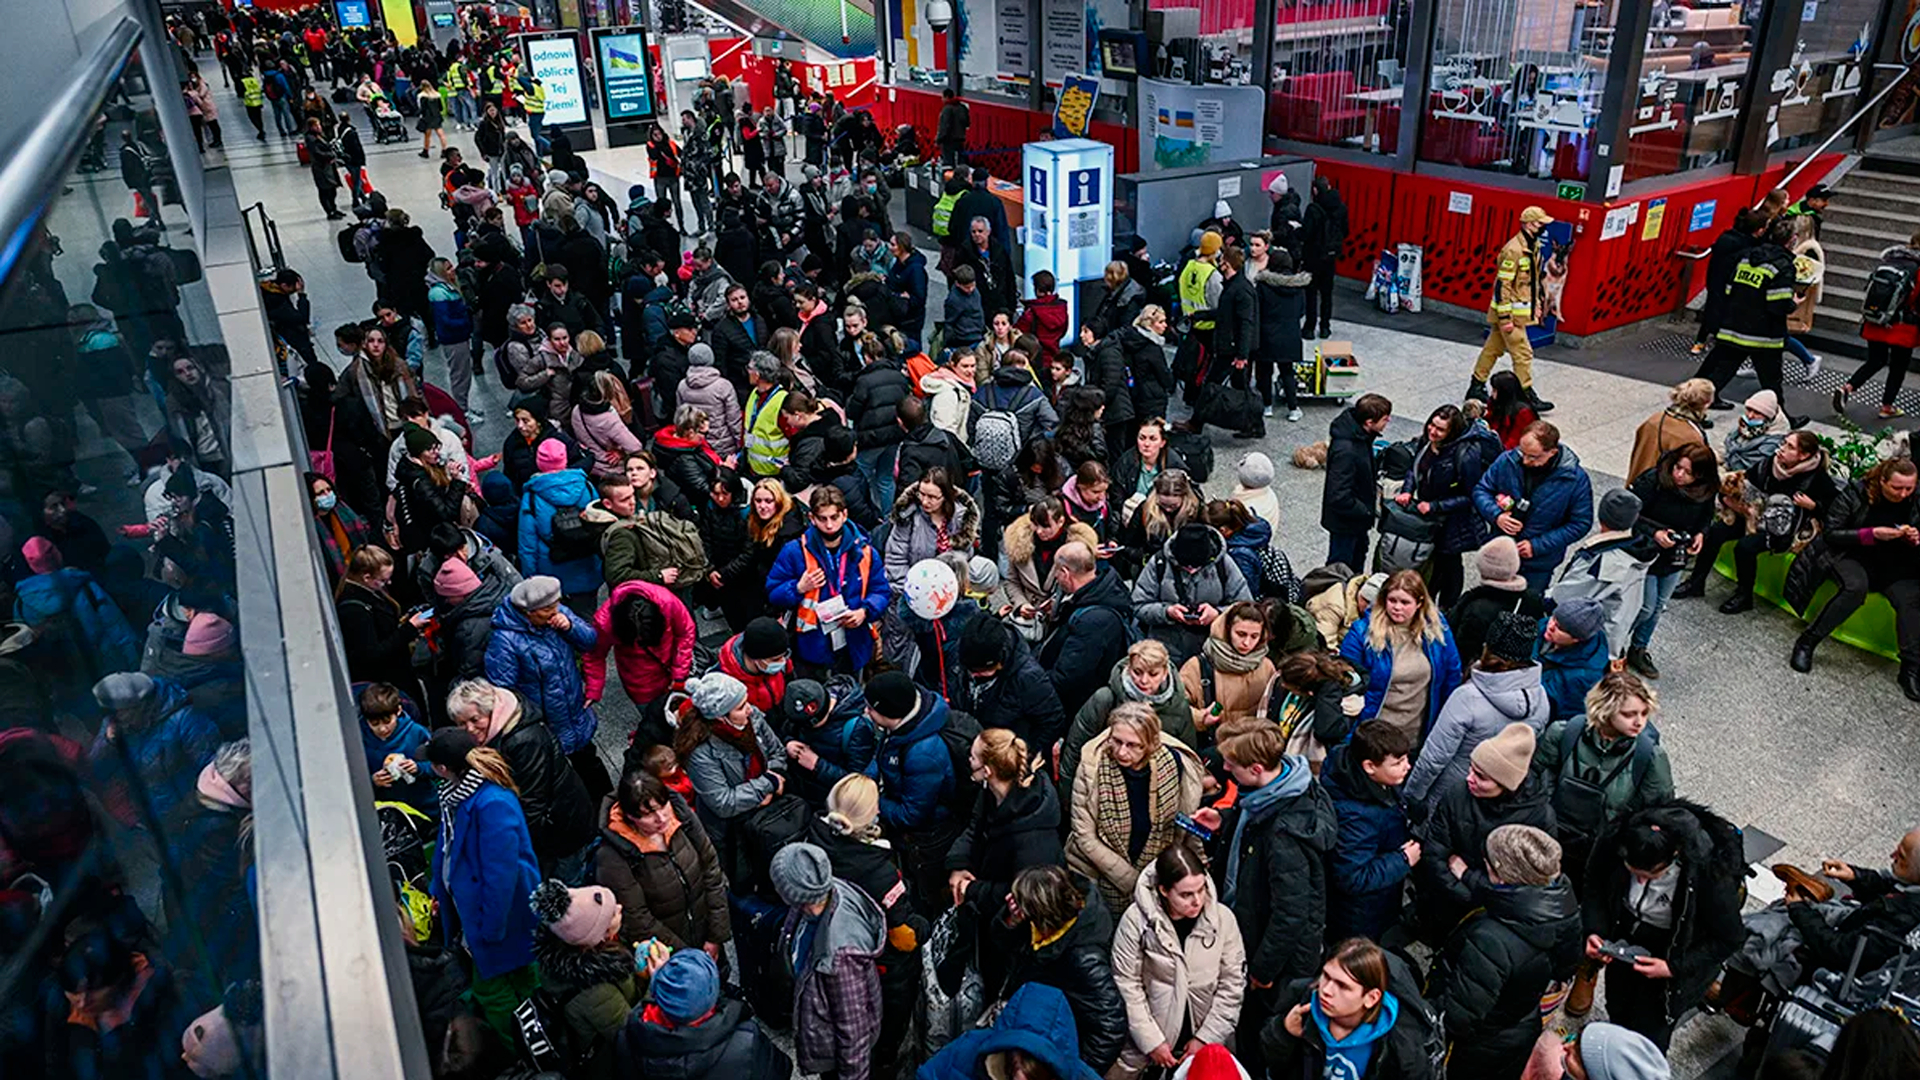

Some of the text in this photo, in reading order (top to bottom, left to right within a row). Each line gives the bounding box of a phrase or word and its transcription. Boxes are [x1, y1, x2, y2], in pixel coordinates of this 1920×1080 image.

[533, 48, 573, 61] odnowi
[537, 66, 575, 78] oblicze
[551, 82, 567, 94] Tej
[544, 98, 578, 111] Ziemi!
